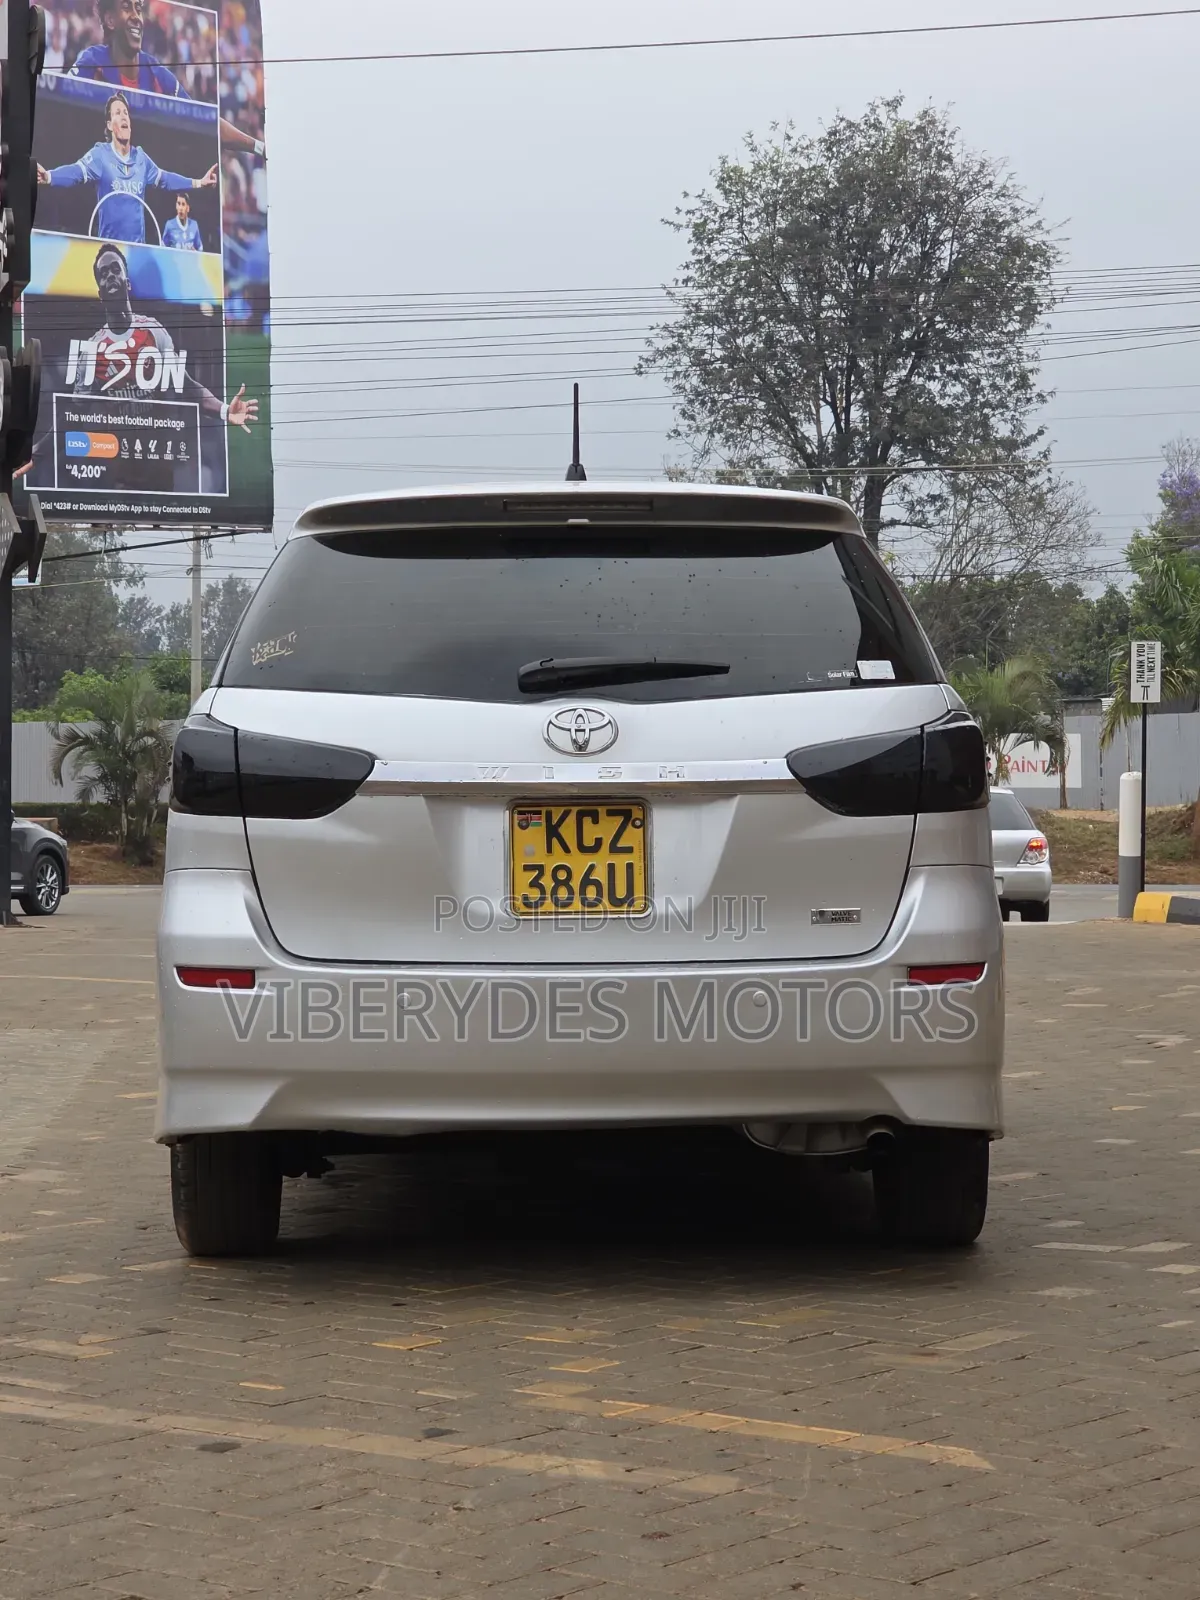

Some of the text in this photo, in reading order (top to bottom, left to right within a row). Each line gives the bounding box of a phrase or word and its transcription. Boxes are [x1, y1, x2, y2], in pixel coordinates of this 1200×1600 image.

[65, 339, 187, 393] IT'S ON
[65, 412, 185, 431] The world's best football package
[92, 442, 115, 450] Compact
[71, 464, 101, 479] 4,200
[41, 502, 53, 510] Dial
[79, 503, 108, 511] Download
[131, 504, 142, 514] App
[150, 505, 161, 514] stay
[162, 505, 192, 513] Connected
[198, 506, 211, 514] DStv
[1136, 643, 1146, 683] THANK YOU
[1146, 656, 1156, 672] NEXT
[477, 766, 686, 780] WISH
[545, 809, 634, 855] KCZ
[521, 862, 635, 909] 386U
